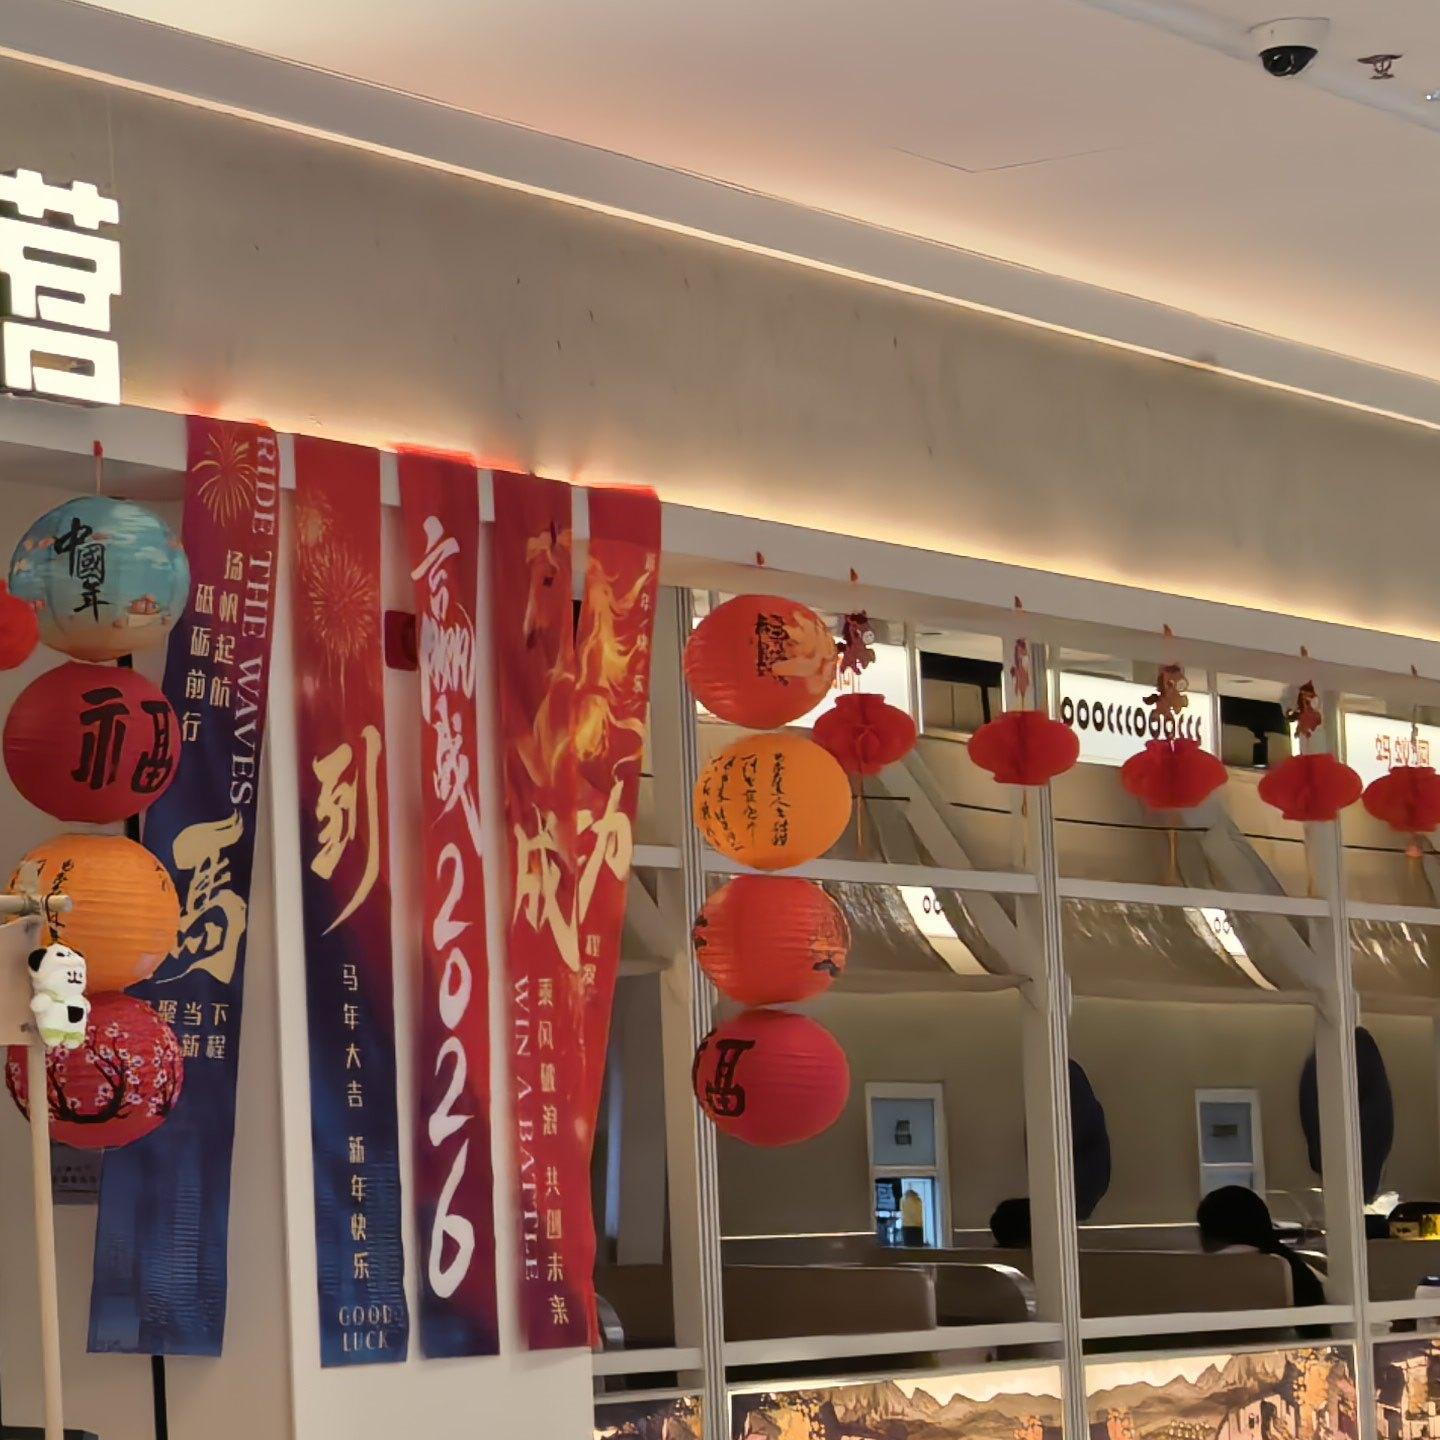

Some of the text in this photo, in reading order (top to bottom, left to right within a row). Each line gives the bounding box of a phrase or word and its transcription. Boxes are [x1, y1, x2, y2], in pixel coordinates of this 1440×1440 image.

[181, 582, 216, 743] 砥砺前行
[229, 435, 278, 806] RIDE THE WAVES
[70, 687, 173, 794] 福
[341, 963, 371, 1281] 马年大吉 新年快乐
[338, 1304, 393, 1327] GOOD
